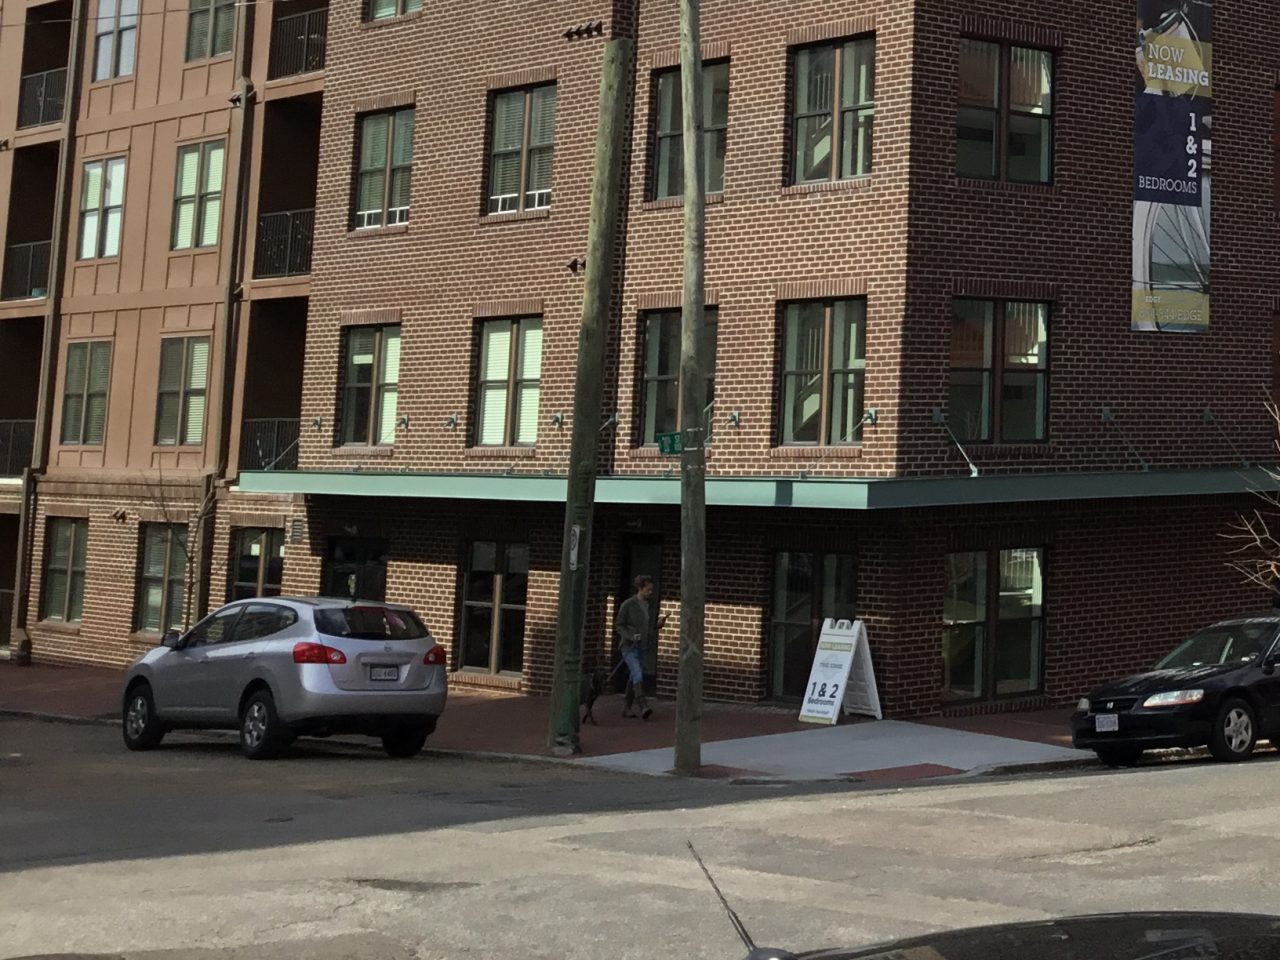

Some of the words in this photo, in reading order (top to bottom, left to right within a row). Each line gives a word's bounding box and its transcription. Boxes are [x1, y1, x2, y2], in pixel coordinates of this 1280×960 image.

[1148, 43, 1184, 63] NOW
[1148, 62, 1209, 86] LEASING
[1189, 112, 1197, 131] 1
[1186, 135, 1198, 154] &
[1187, 159, 1197, 178] 2
[1138, 176, 1198, 194] BEDROOMS
[811, 681, 817, 697] 1
[818, 682, 827, 697] &
[829, 683, 839, 698] 2
